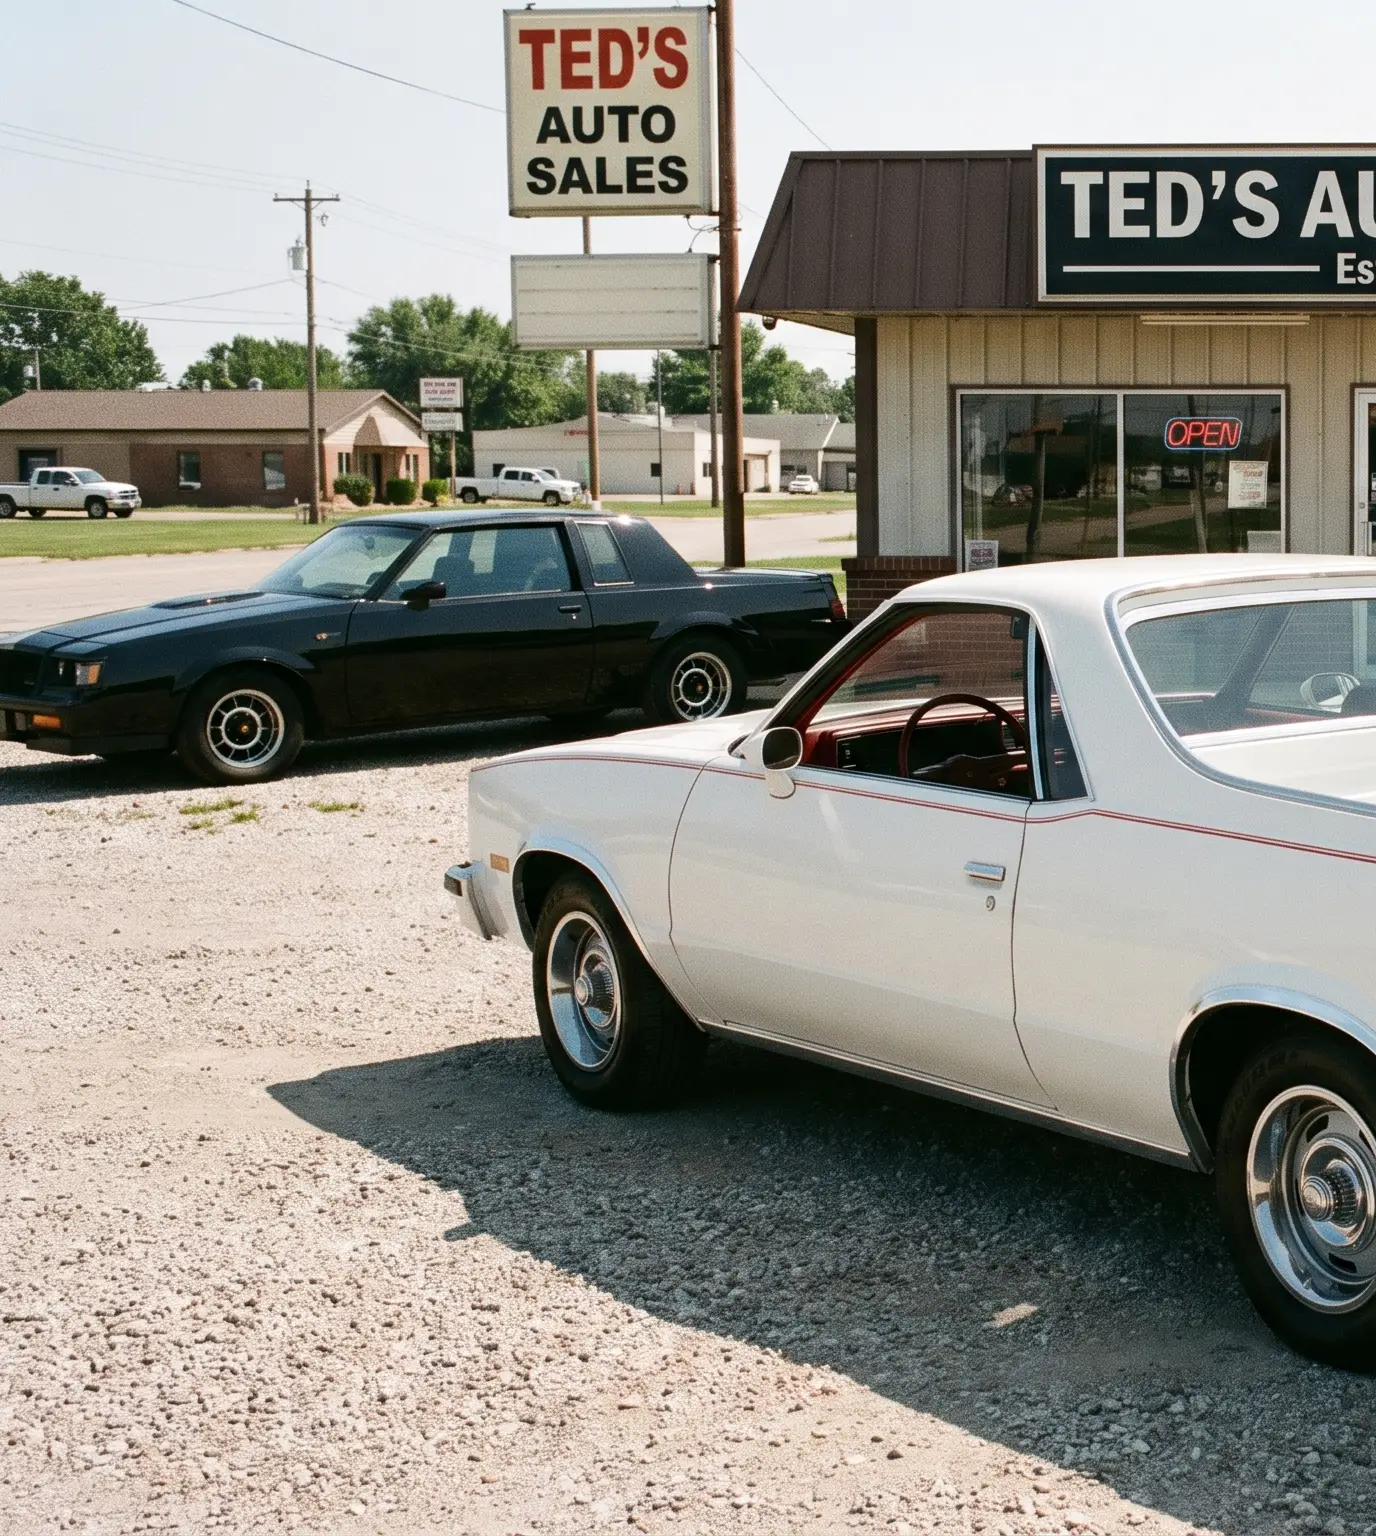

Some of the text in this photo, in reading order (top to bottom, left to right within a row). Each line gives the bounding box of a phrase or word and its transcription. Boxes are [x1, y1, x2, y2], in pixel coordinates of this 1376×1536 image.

[519, 27, 689, 90] TED'S
[536, 105, 676, 144] AUTO
[526, 156, 689, 195] SALES
[1060, 170, 1280, 239] TED'S
[1168, 421, 1239, 446] OPEN
